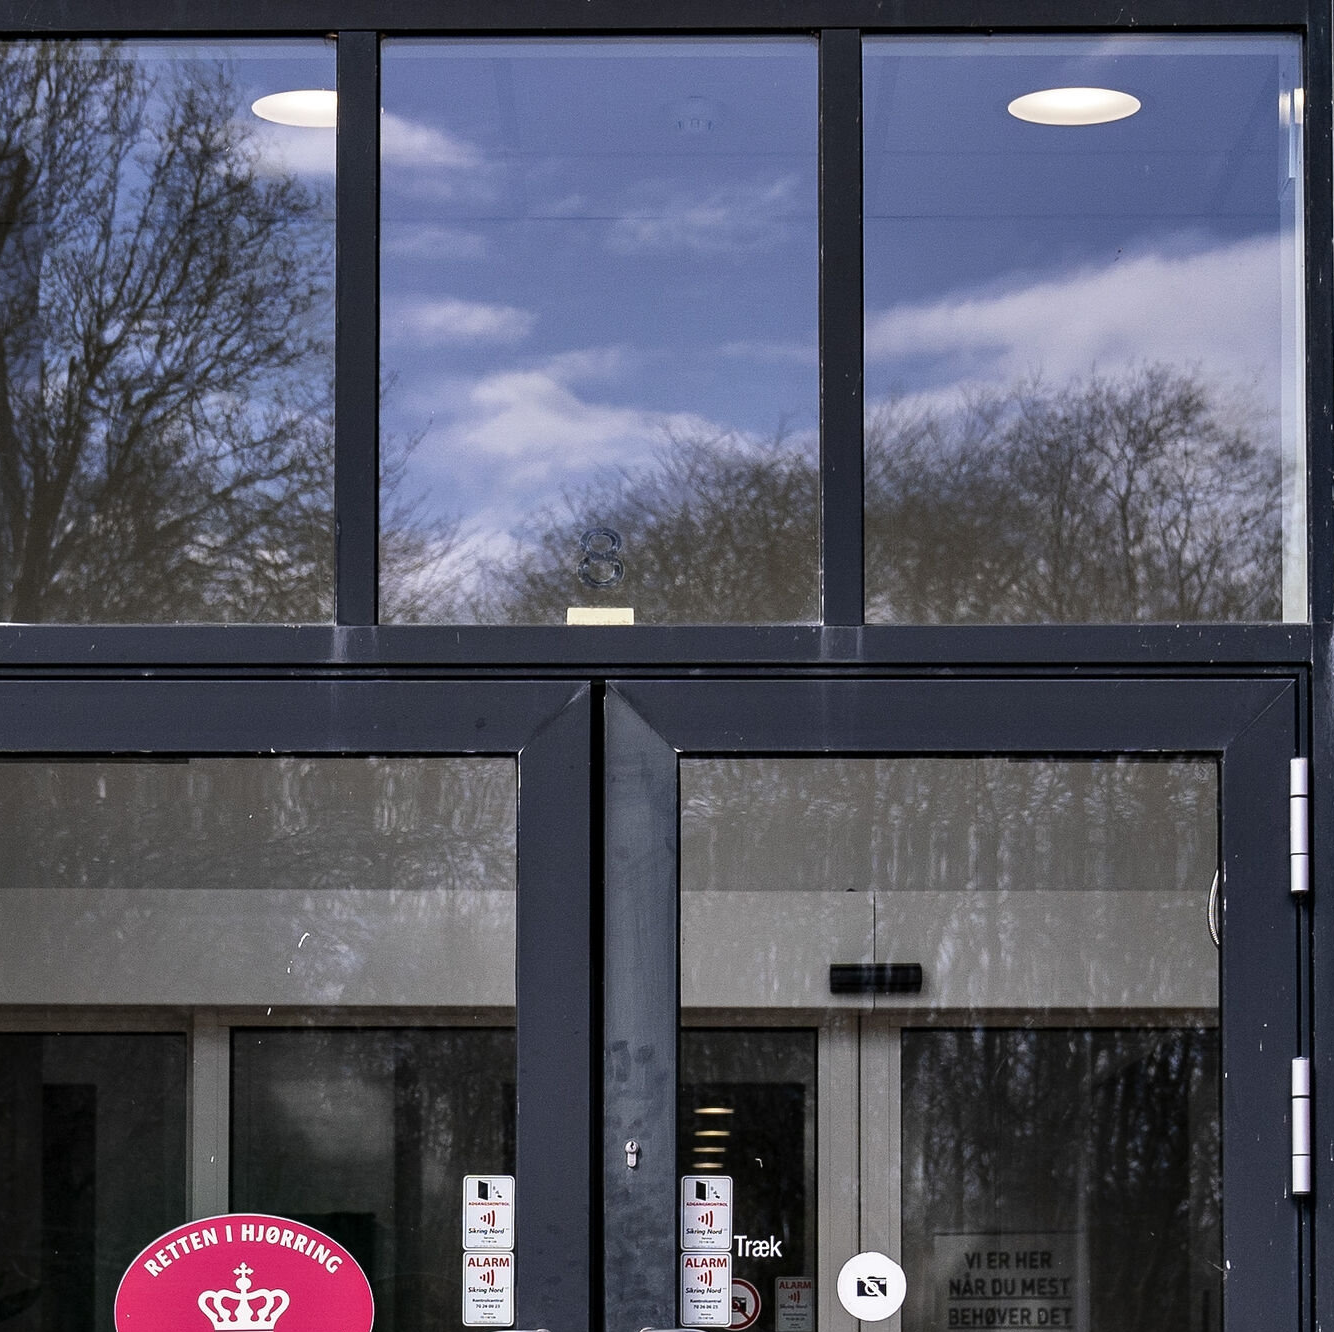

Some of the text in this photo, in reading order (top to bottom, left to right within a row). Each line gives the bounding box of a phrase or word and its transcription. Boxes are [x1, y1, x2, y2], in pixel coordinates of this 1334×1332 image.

[578, 527, 624, 588] 8
[143, 1223, 343, 1278] RETTEN I HJØRRING
[733, 1235, 783, 1258] Træk
[467, 1257, 510, 1267] ALARM
[685, 1258, 727, 1268] ALARM
[964, 1252, 1052, 1269] VI ER HER
[779, 1281, 812, 1289] ALARM
[949, 1272, 1072, 1296] NÅR DU MEST
[948, 1307, 1073, 1326] BEHØVER DET
